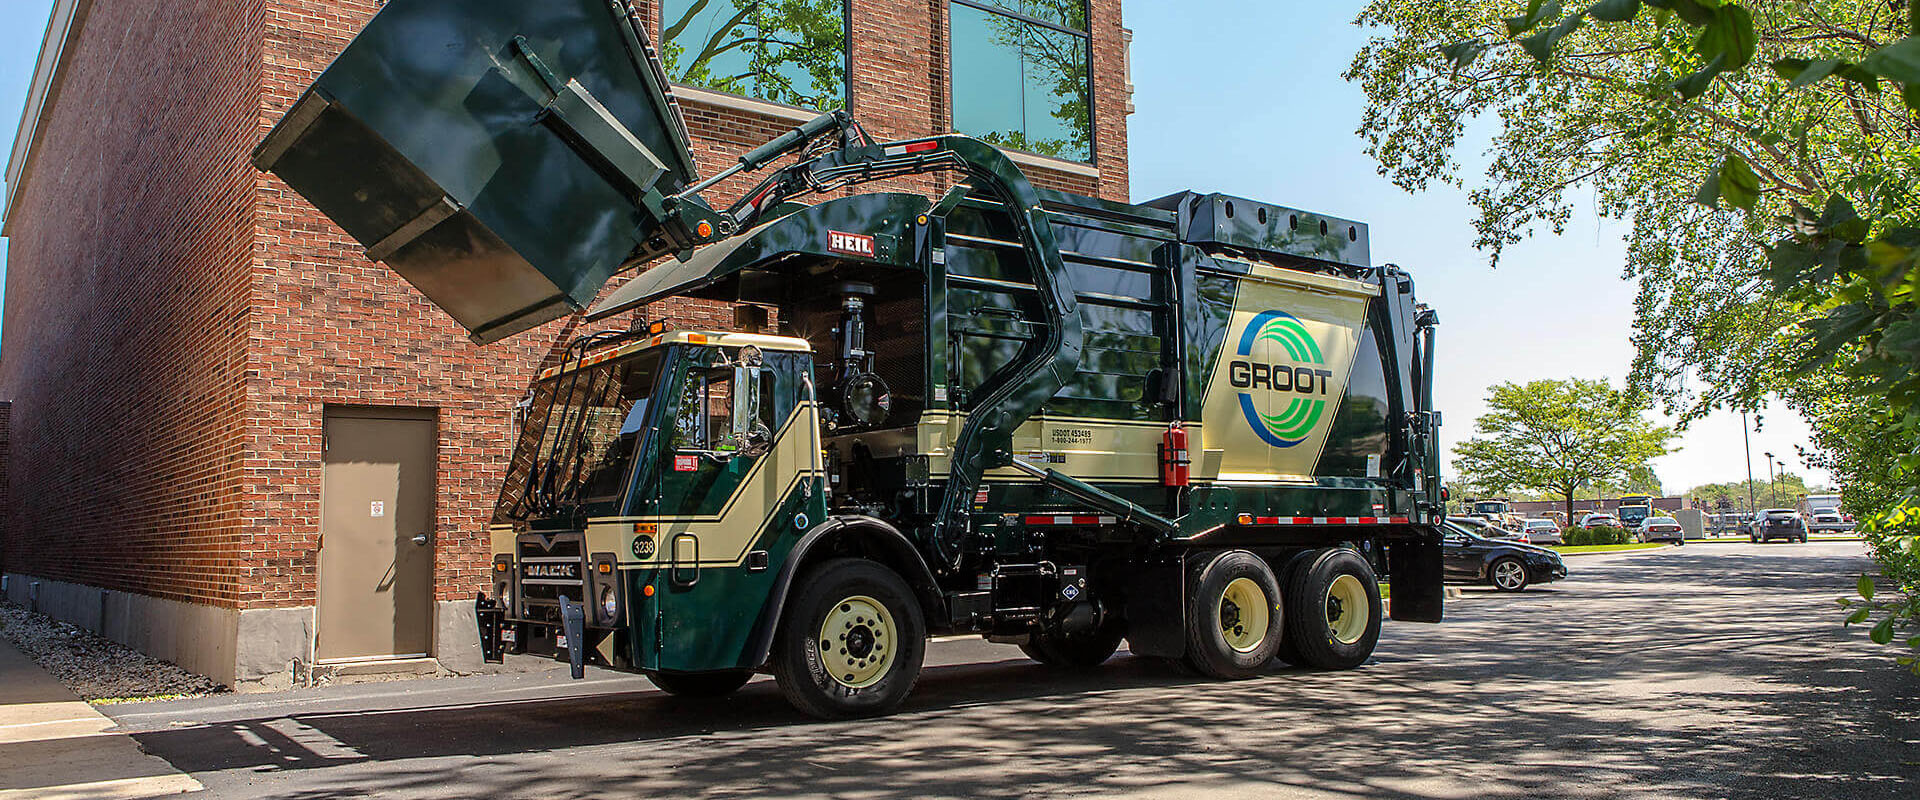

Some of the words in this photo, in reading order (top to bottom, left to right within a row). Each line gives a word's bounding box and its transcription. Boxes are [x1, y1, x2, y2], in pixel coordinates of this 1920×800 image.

[831, 233, 872, 254] HEIL
[1229, 360, 1333, 396] GROOT
[1052, 428, 1070, 437] USDOT
[634, 540, 655, 554] 3238
[527, 564, 576, 577] MACK
